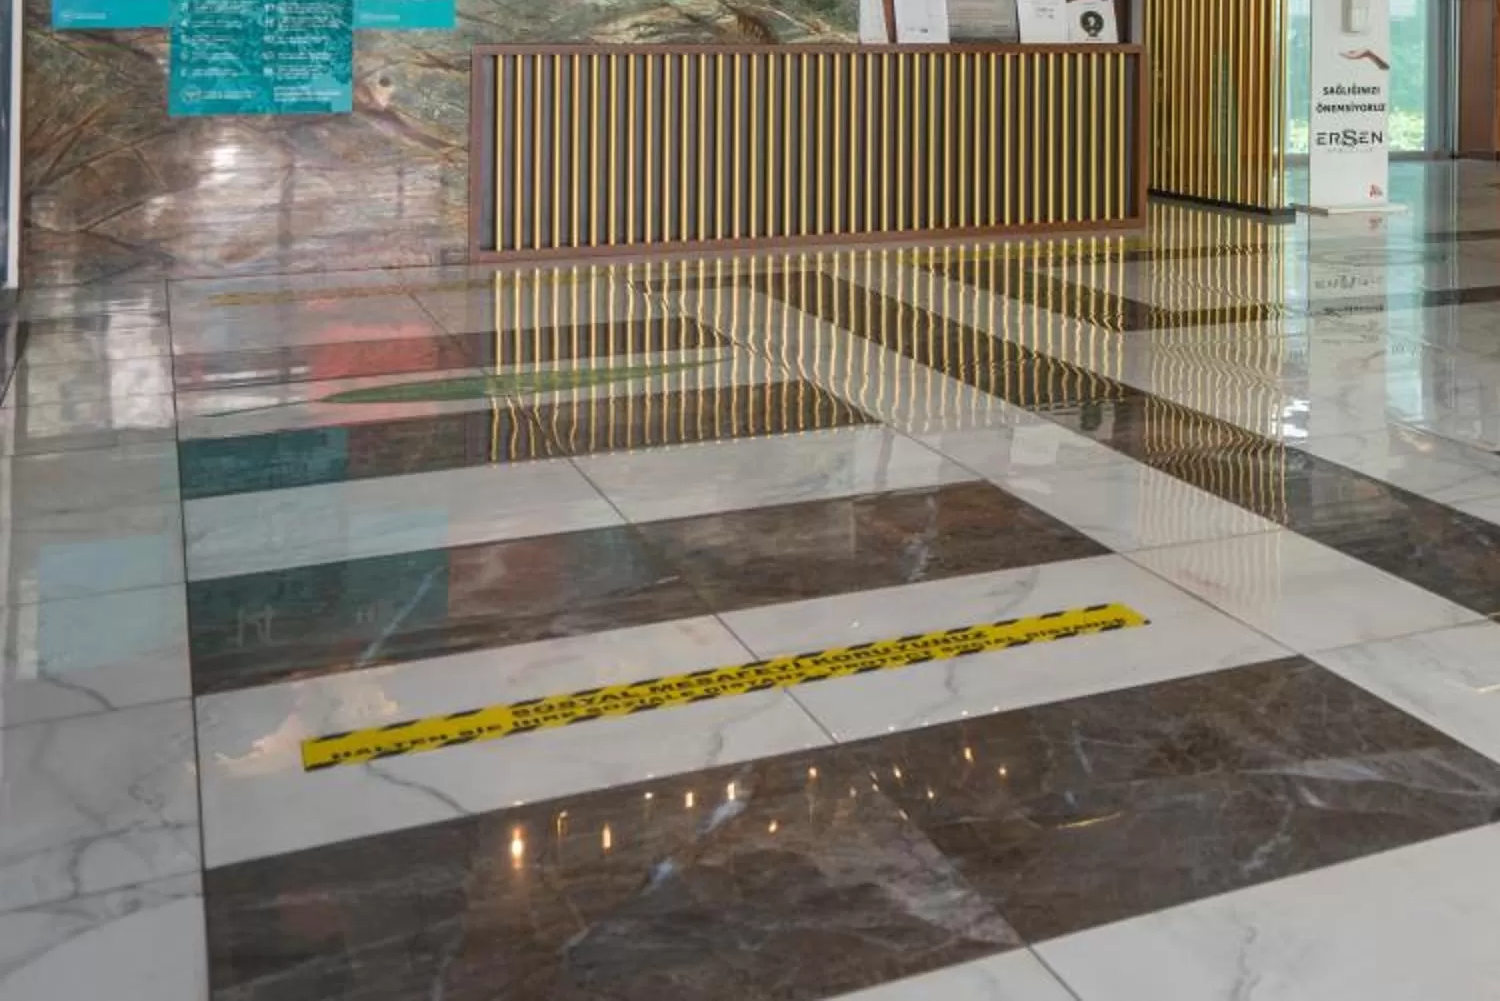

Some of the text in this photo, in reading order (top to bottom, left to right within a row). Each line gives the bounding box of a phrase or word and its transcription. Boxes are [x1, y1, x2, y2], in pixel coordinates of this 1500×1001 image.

[1316, 129, 1383, 147] ERSEN
[511, 690, 636, 717] SOSYAL
[811, 631, 986, 666] KORUYUNUZ
[331, 733, 448, 759] HALTEN
